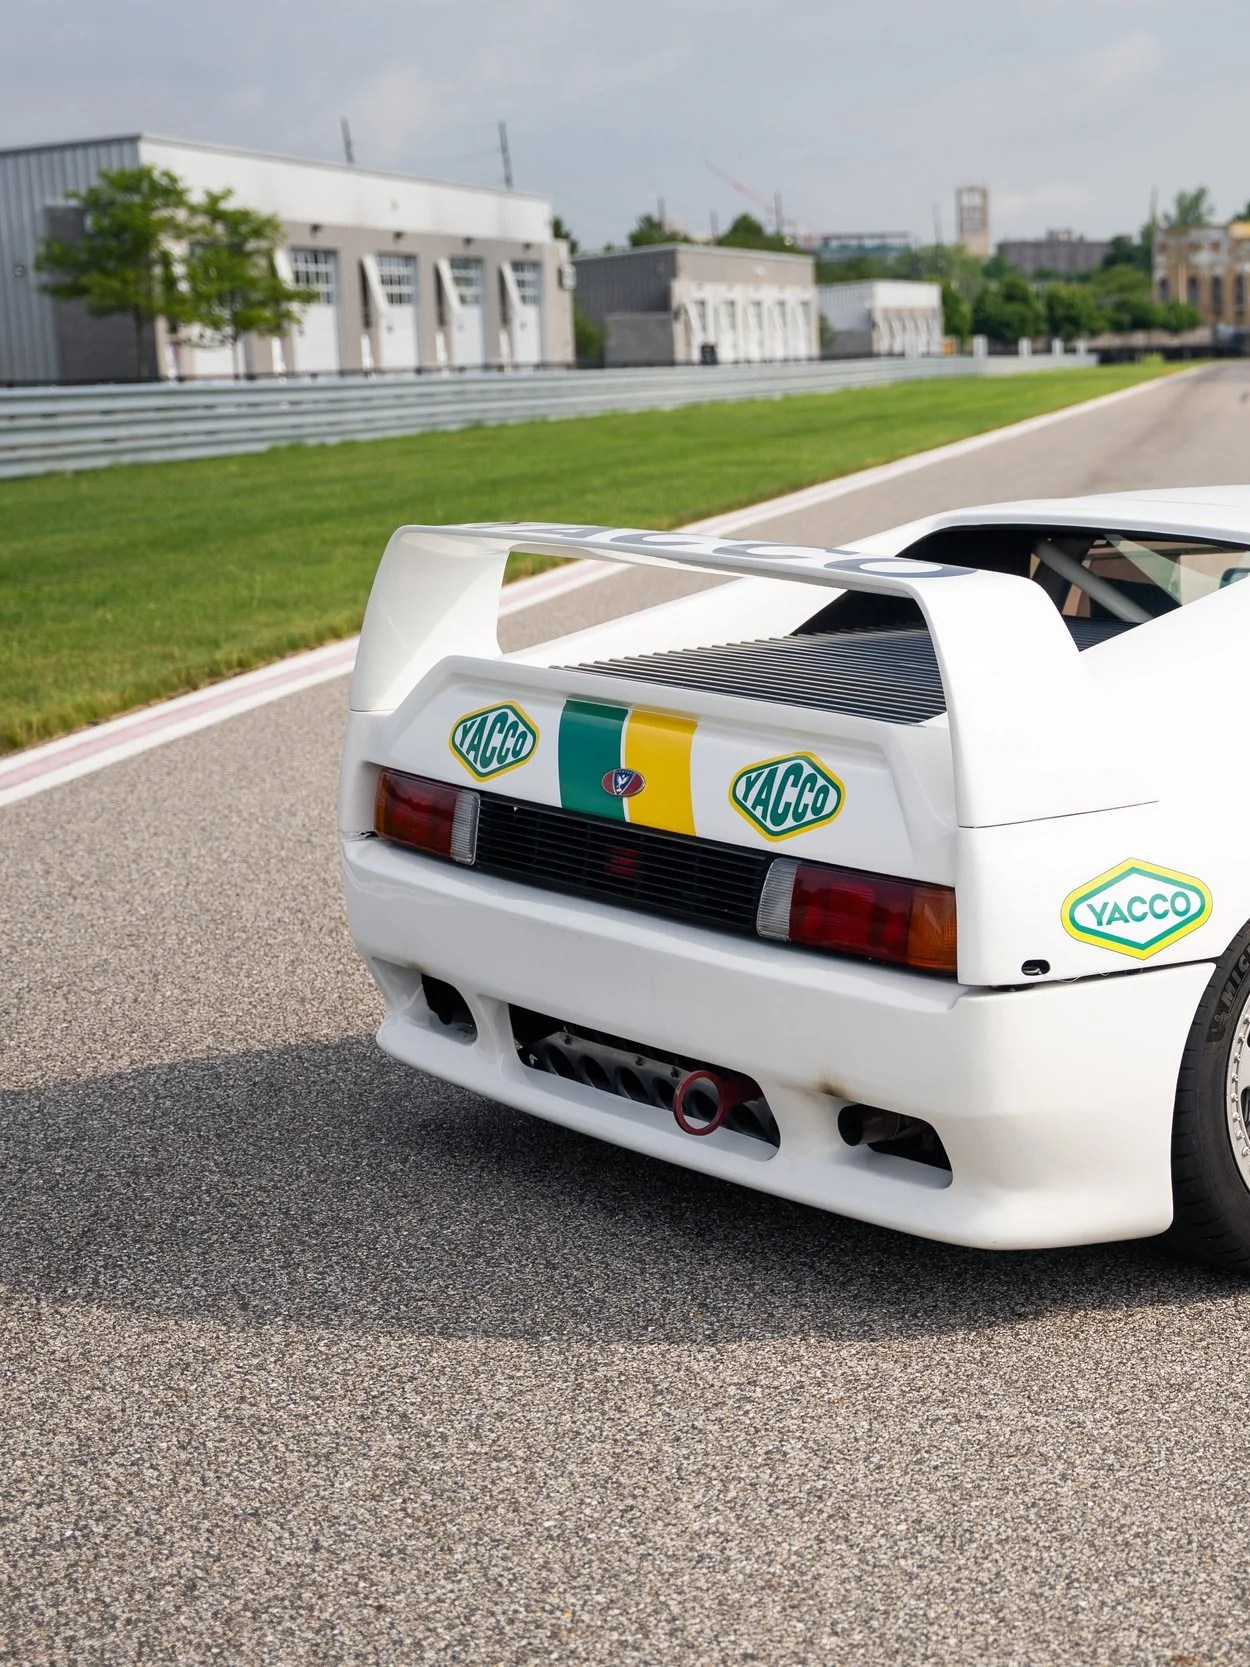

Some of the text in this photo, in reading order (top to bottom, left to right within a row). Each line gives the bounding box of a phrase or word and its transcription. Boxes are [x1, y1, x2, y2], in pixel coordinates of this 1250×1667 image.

[459, 711, 528, 768] YACCO
[742, 763, 830, 827] YACCO
[1086, 891, 1191, 927] YACCO
